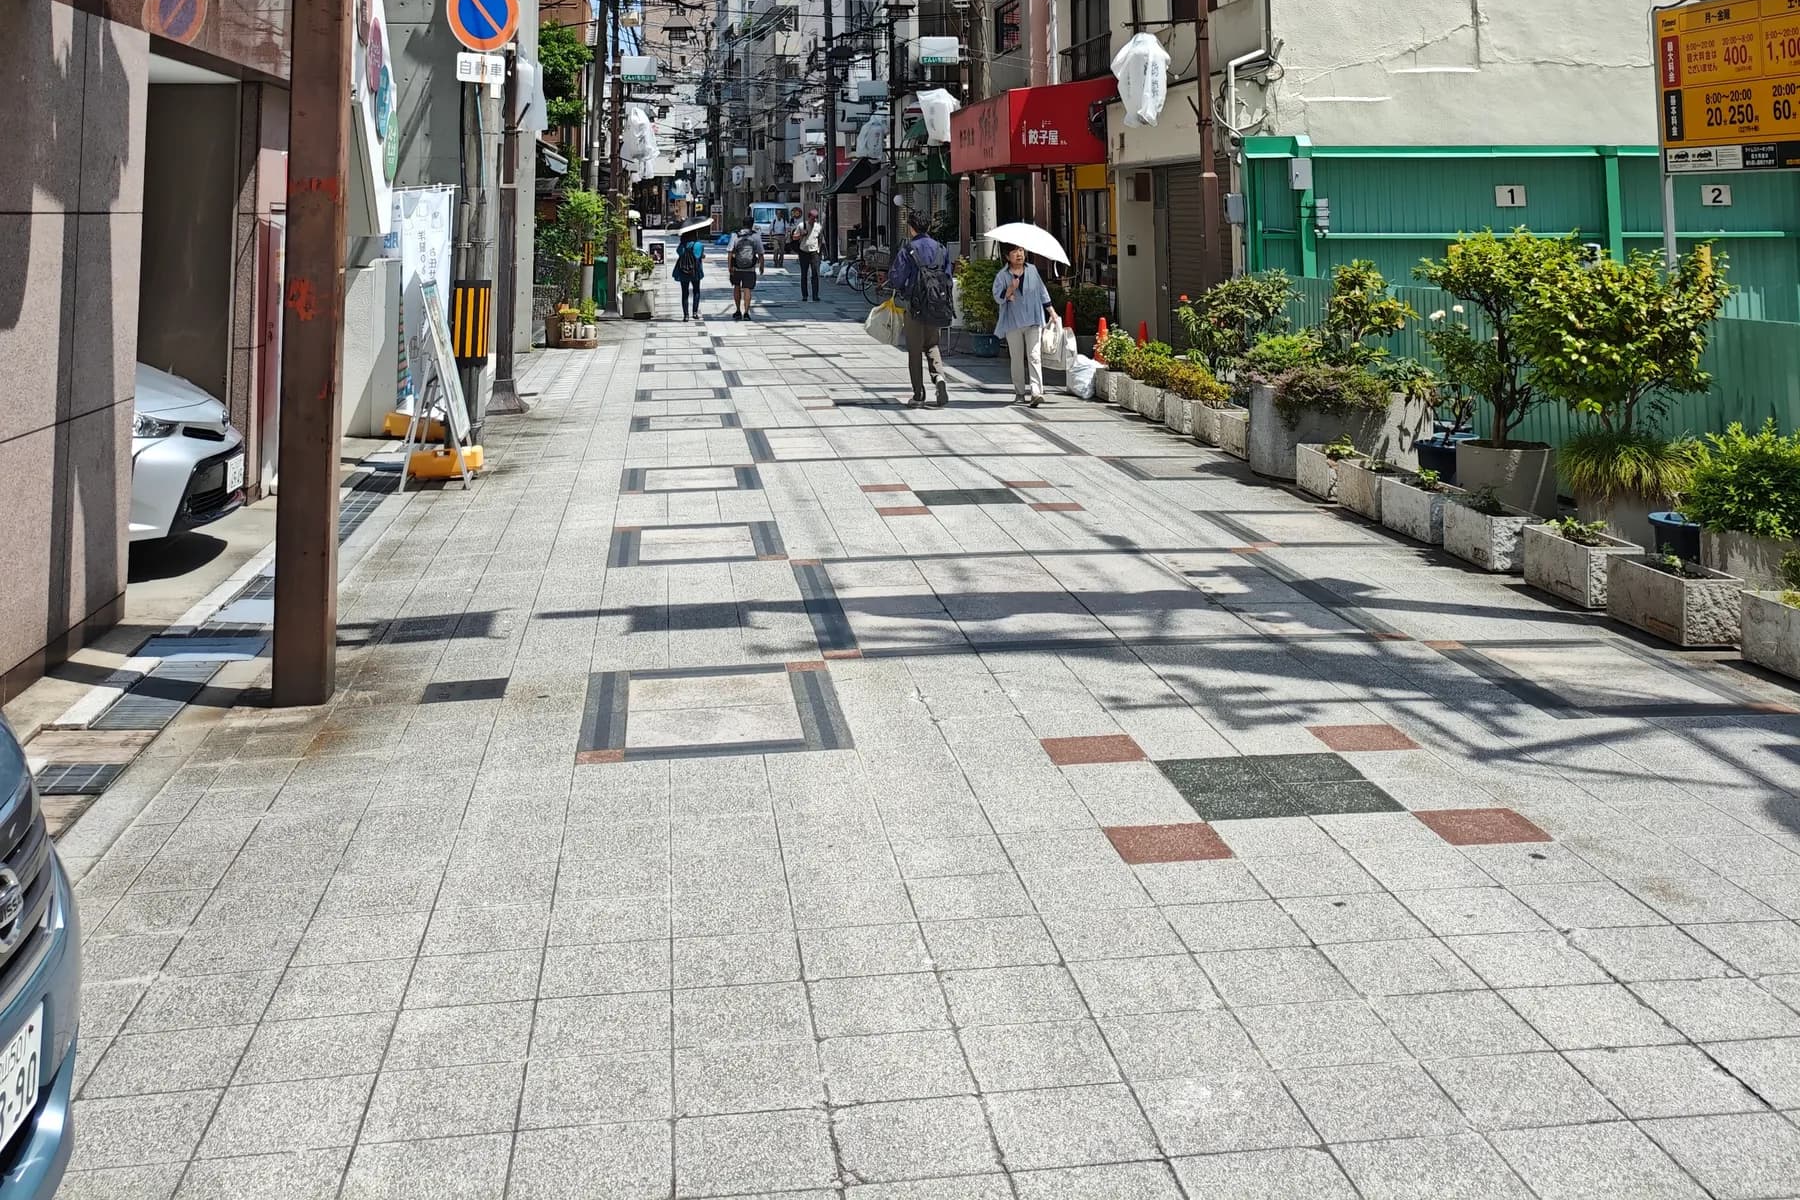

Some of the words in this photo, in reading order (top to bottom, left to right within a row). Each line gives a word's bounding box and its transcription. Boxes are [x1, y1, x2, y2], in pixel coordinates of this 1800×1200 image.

[460, 60, 503, 76] 自動車
[1028, 128, 1059, 146] 餃子屋
[1507, 188, 1516, 205] 1
[1711, 187, 1724, 205] 2
